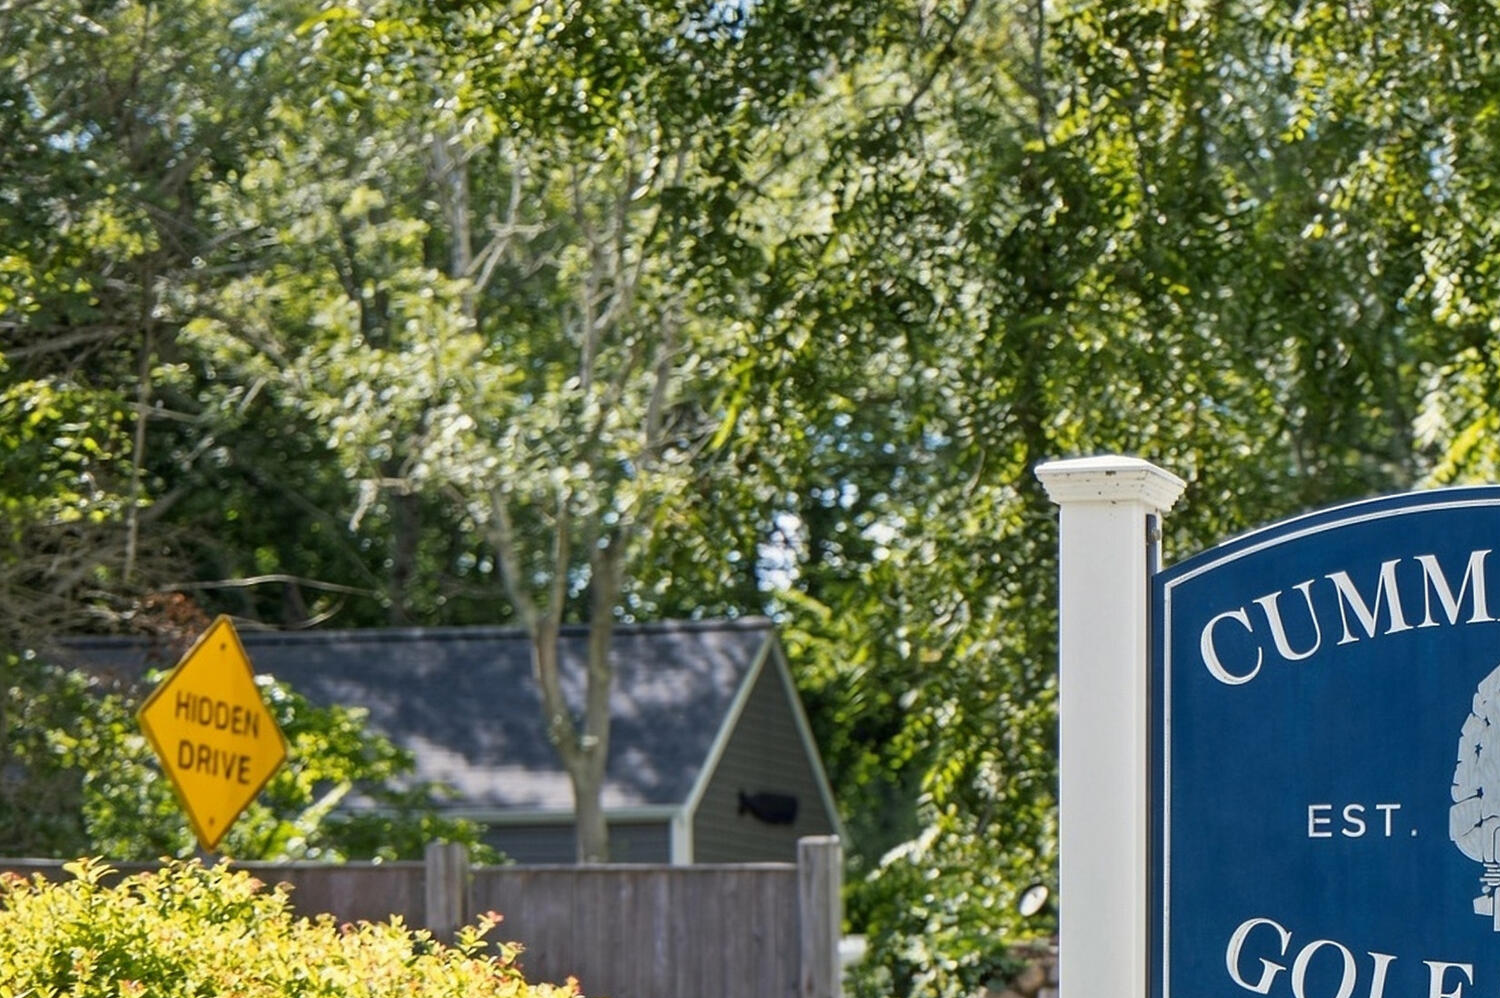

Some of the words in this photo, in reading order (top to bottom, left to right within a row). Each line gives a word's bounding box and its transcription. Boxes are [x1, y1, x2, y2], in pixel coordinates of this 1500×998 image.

[175, 690, 260, 738] HIDDEN
[178, 739, 252, 785] DRIVE
[1308, 803, 1419, 838] EST.
